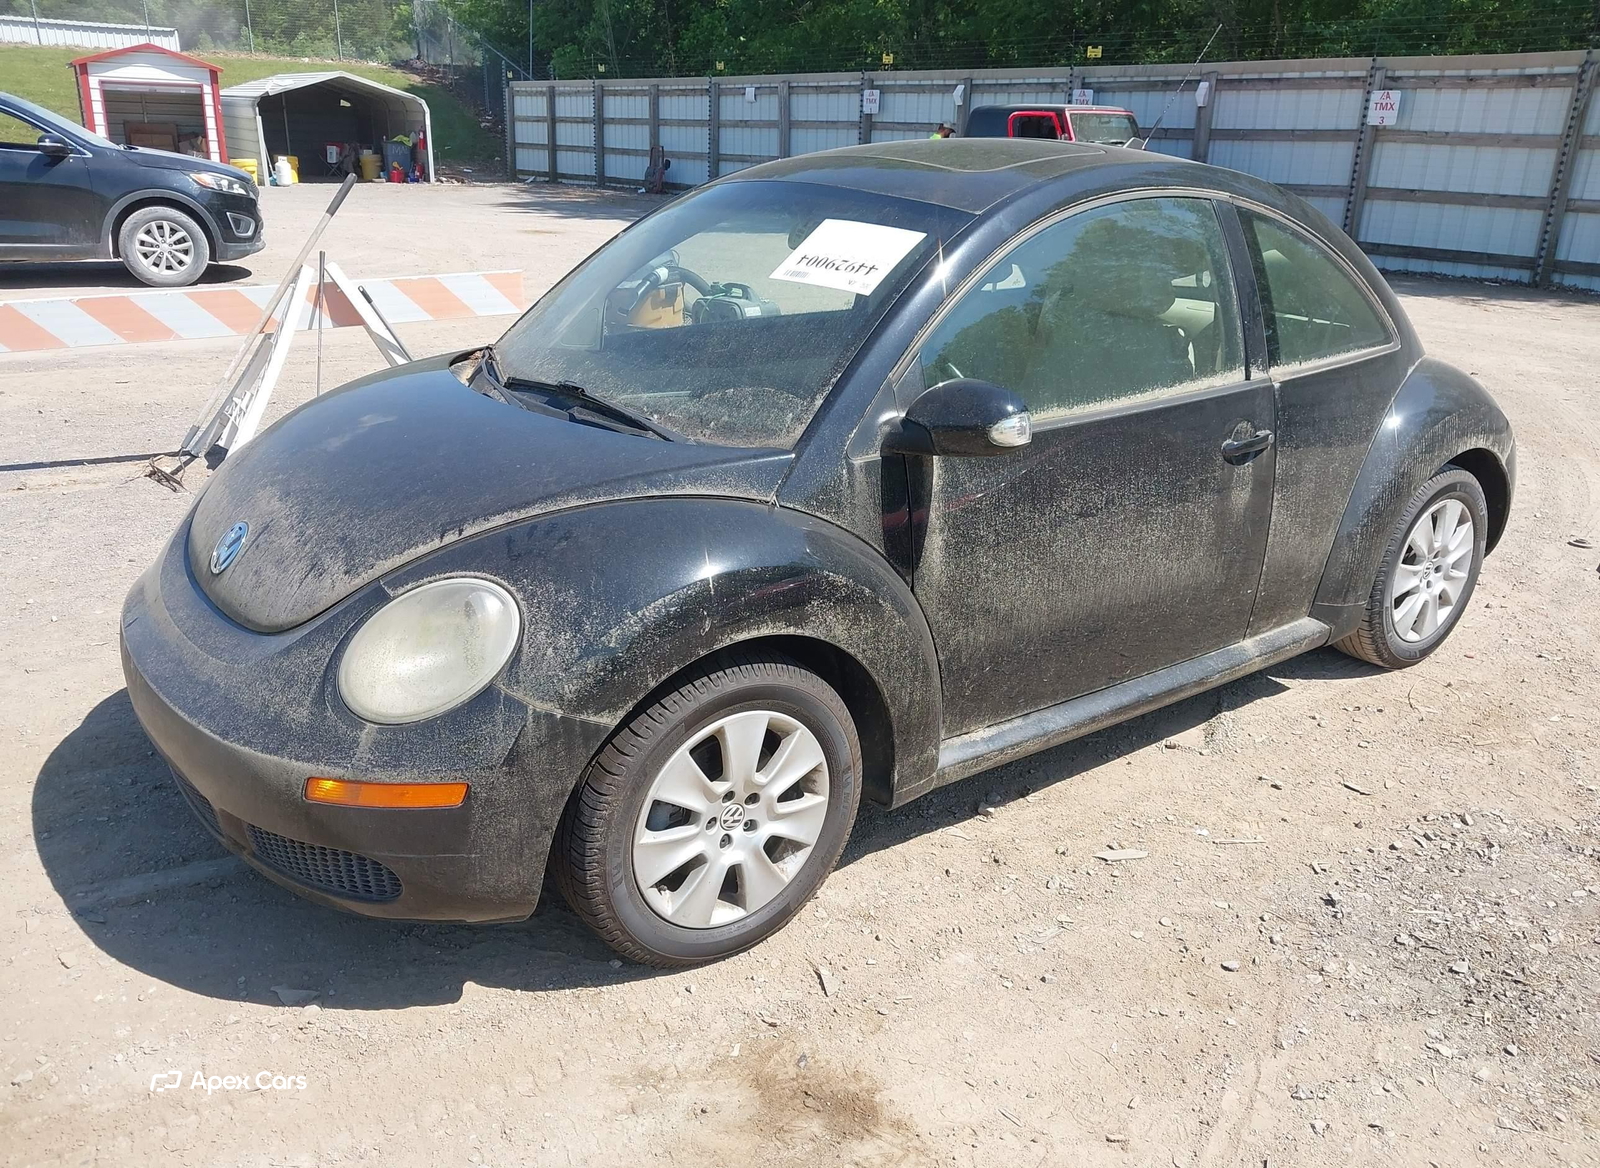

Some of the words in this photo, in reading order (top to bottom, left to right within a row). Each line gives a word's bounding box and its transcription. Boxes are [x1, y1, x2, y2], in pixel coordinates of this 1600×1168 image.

[1373, 102, 1396, 111] TMX
[1378, 116, 1385, 125] 3
[796, 254, 879, 276] 44929004
